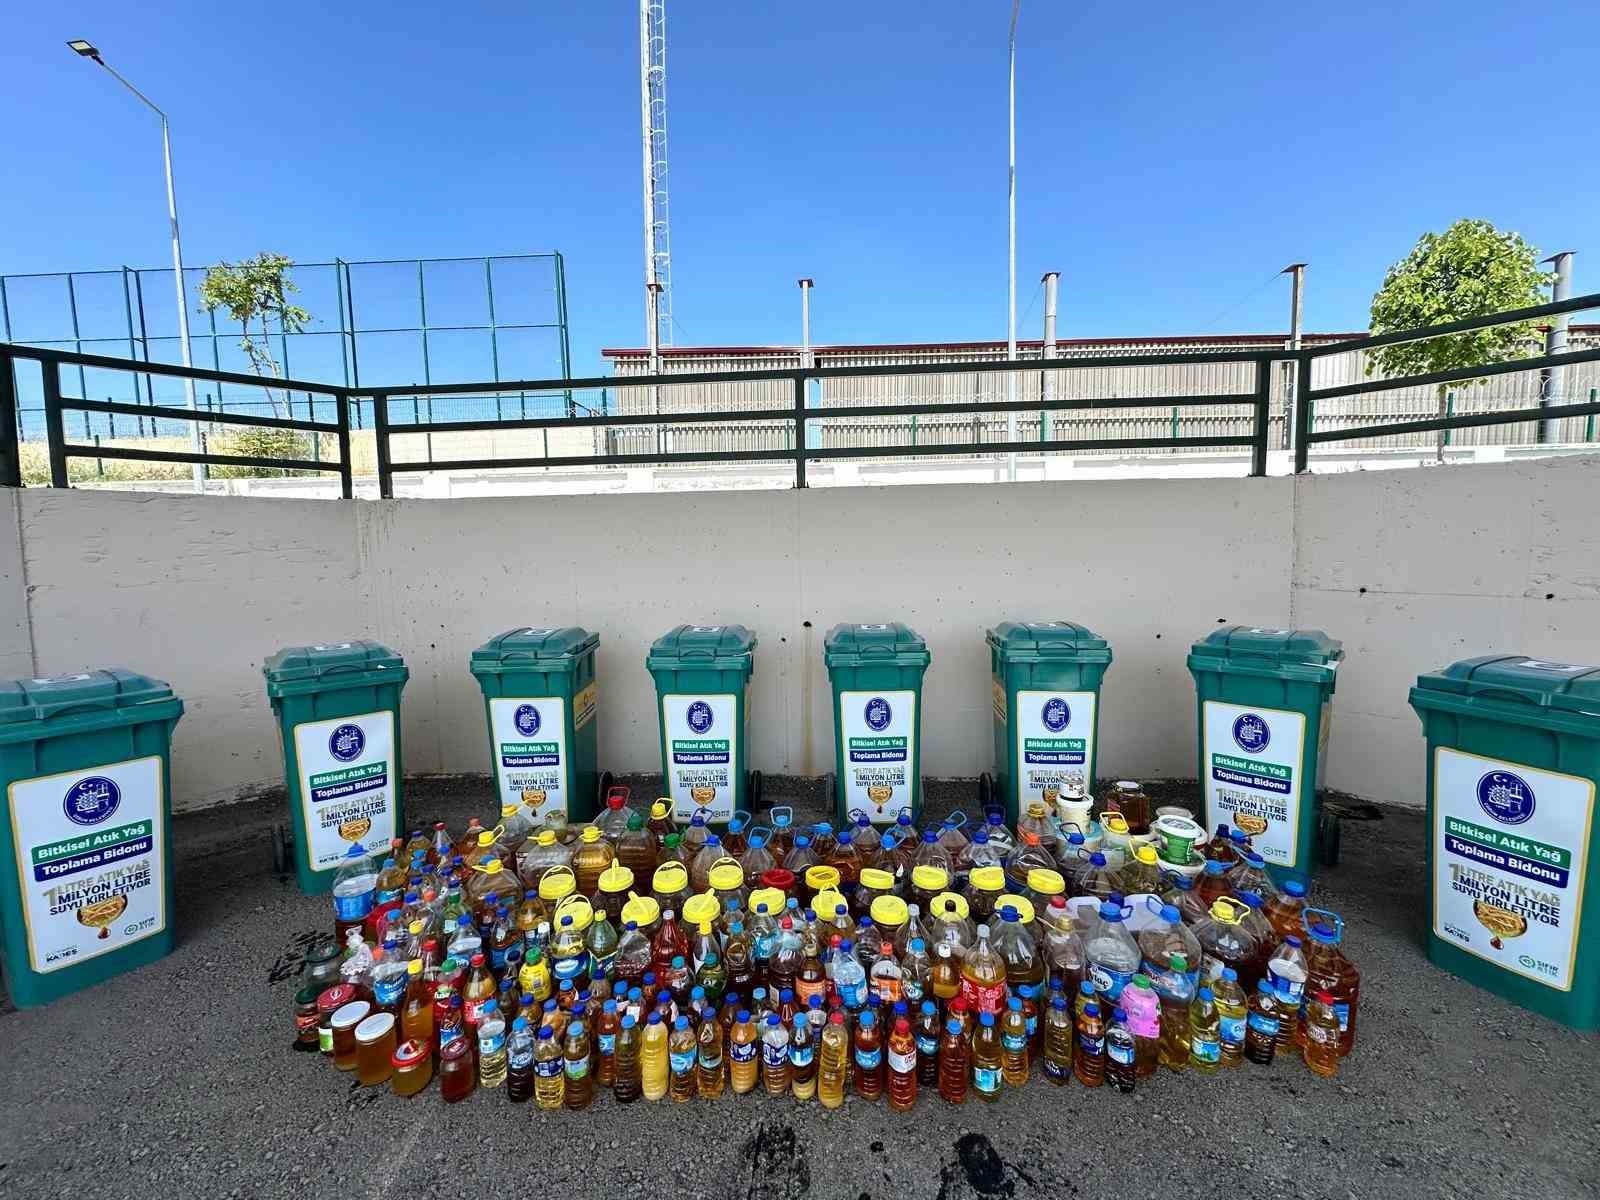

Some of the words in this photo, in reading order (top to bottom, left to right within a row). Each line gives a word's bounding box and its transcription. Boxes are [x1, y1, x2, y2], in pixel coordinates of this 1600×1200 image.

[314, 774, 346, 785] Bitkisel
[348, 770, 365, 778] Atık
[368, 765, 382, 774] Yağ
[1216, 756, 1246, 769] Bitkisel
[1248, 761, 1267, 773] Atık
[1268, 767, 1286, 777] Yağ
[1217, 770, 1252, 784] Toplama
[1254, 776, 1286, 790] Bidonu
[316, 785, 353, 798] Toplama
[354, 778, 384, 790] Bidonu
[326, 807, 360, 820] MİLYON
[362, 800, 386, 812] LİTRE
[1224, 796, 1258, 810] MİLYON
[1260, 803, 1287, 815] LİTRE
[1240, 807, 1287, 822] KİRLETİYOR
[38, 839, 89, 859] Bitkisel
[94, 831, 119, 847] Atık
[124, 824, 145, 840] Yağ
[1450, 821, 1496, 844] Bitkisel
[1500, 832, 1529, 853] Atık
[1534, 842, 1561, 863] Yağ
[43, 854, 101, 876] Toplama
[104, 841, 147, 860] Bidonu
[1451, 839, 1504, 865] Toplama
[1508, 857, 1560, 881] Bidonu
[58, 882, 111, 904] MİLYON
[114, 870, 151, 888] LİTRE
[97, 869, 123, 885] ATIK
[1498, 875, 1529, 897] ATIK
[1531, 887, 1560, 907] YAĞ
[50, 900, 83, 916] SUYU
[86, 878, 151, 906] KİRLETİYOR
[1452, 882, 1481, 899] SUYU
[1483, 892, 1560, 928] KİRLETİYOR
[1460, 875, 1510, 902] MİLYON
[1515, 892, 1560, 917] LİTRE
